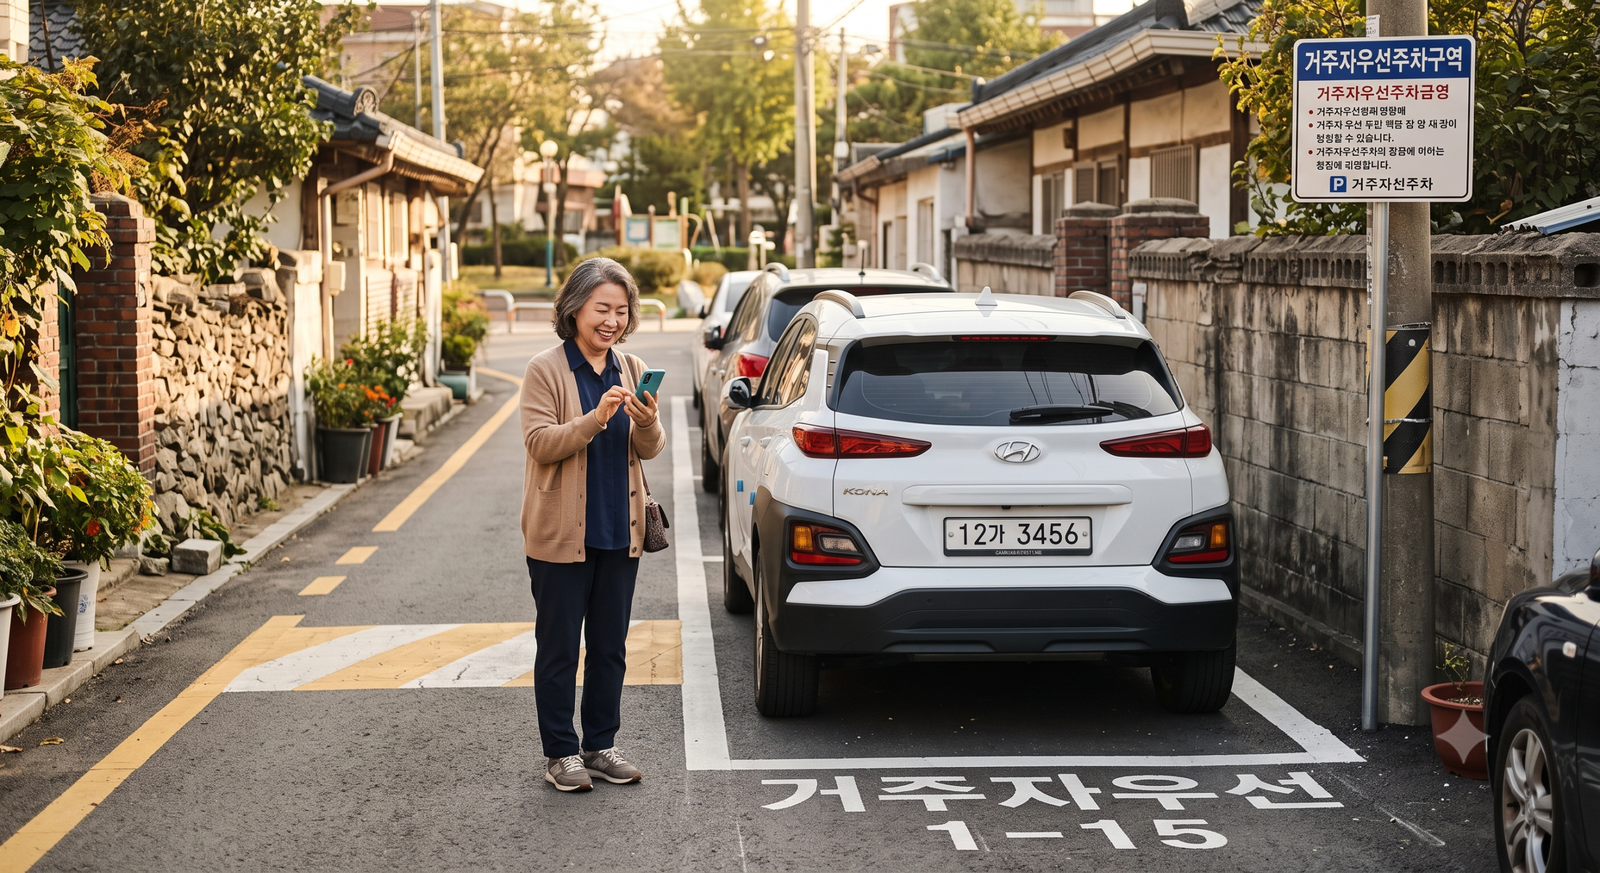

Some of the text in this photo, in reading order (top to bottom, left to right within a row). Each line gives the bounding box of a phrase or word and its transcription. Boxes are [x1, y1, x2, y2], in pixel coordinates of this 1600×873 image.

[1305, 46, 1463, 75] 거주자우선주차구역
[1317, 84, 1450, 101] 거주자우선주차금영
[1316, 120, 1343, 130] 거주자
[1345, 120, 1362, 130] 우선
[1345, 134, 1353, 143] 수
[1356, 133, 1394, 143] 있습니다.
[1333, 177, 1344, 191] P
[843, 487, 888, 496] KONA
[959, 522, 1078, 546] 12가 3456
[761, 771, 1344, 812] 거주자우선
